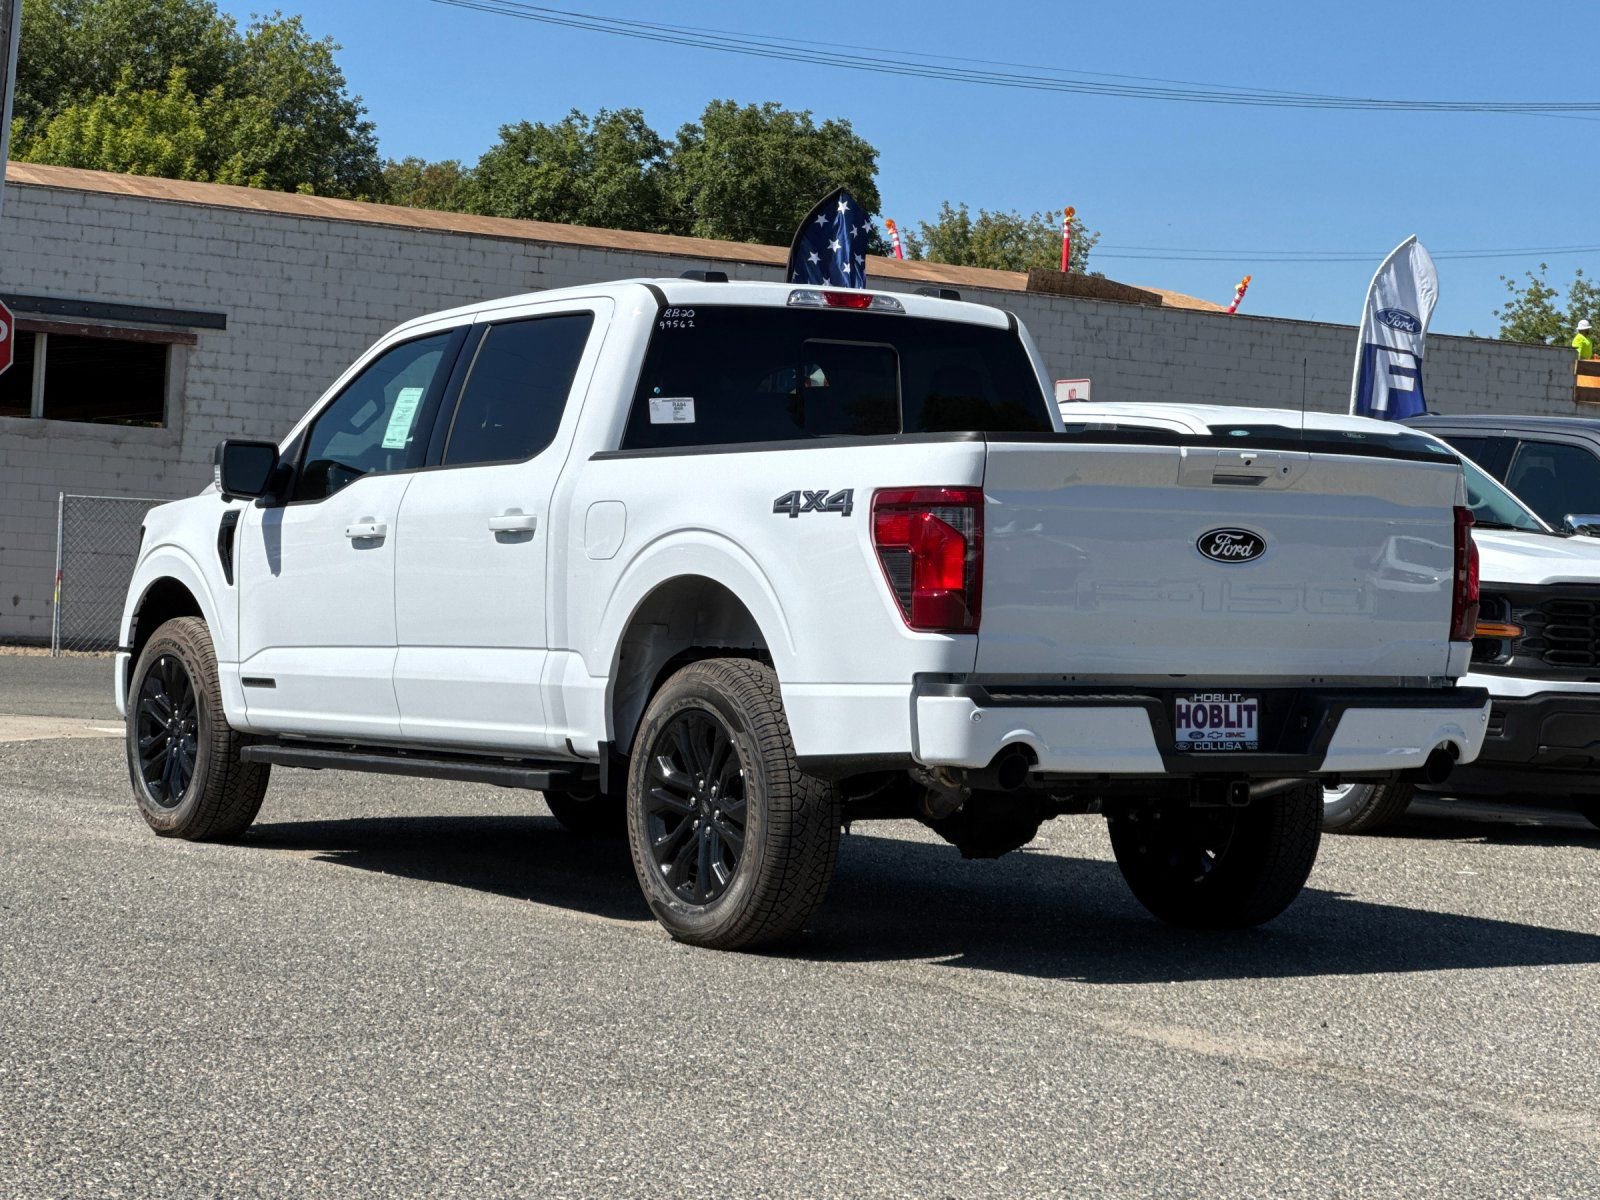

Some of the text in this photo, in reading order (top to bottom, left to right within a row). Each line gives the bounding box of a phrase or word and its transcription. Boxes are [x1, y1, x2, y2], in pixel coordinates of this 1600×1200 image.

[659, 320, 696, 330] 99562
[1385, 311, 1416, 332] Ford
[1210, 533, 1255, 557] Ford
[1193, 693, 1242, 702] HOBLIT
[1176, 703, 1257, 729] HOBLIT
[1193, 741, 1243, 751] COLUSA
